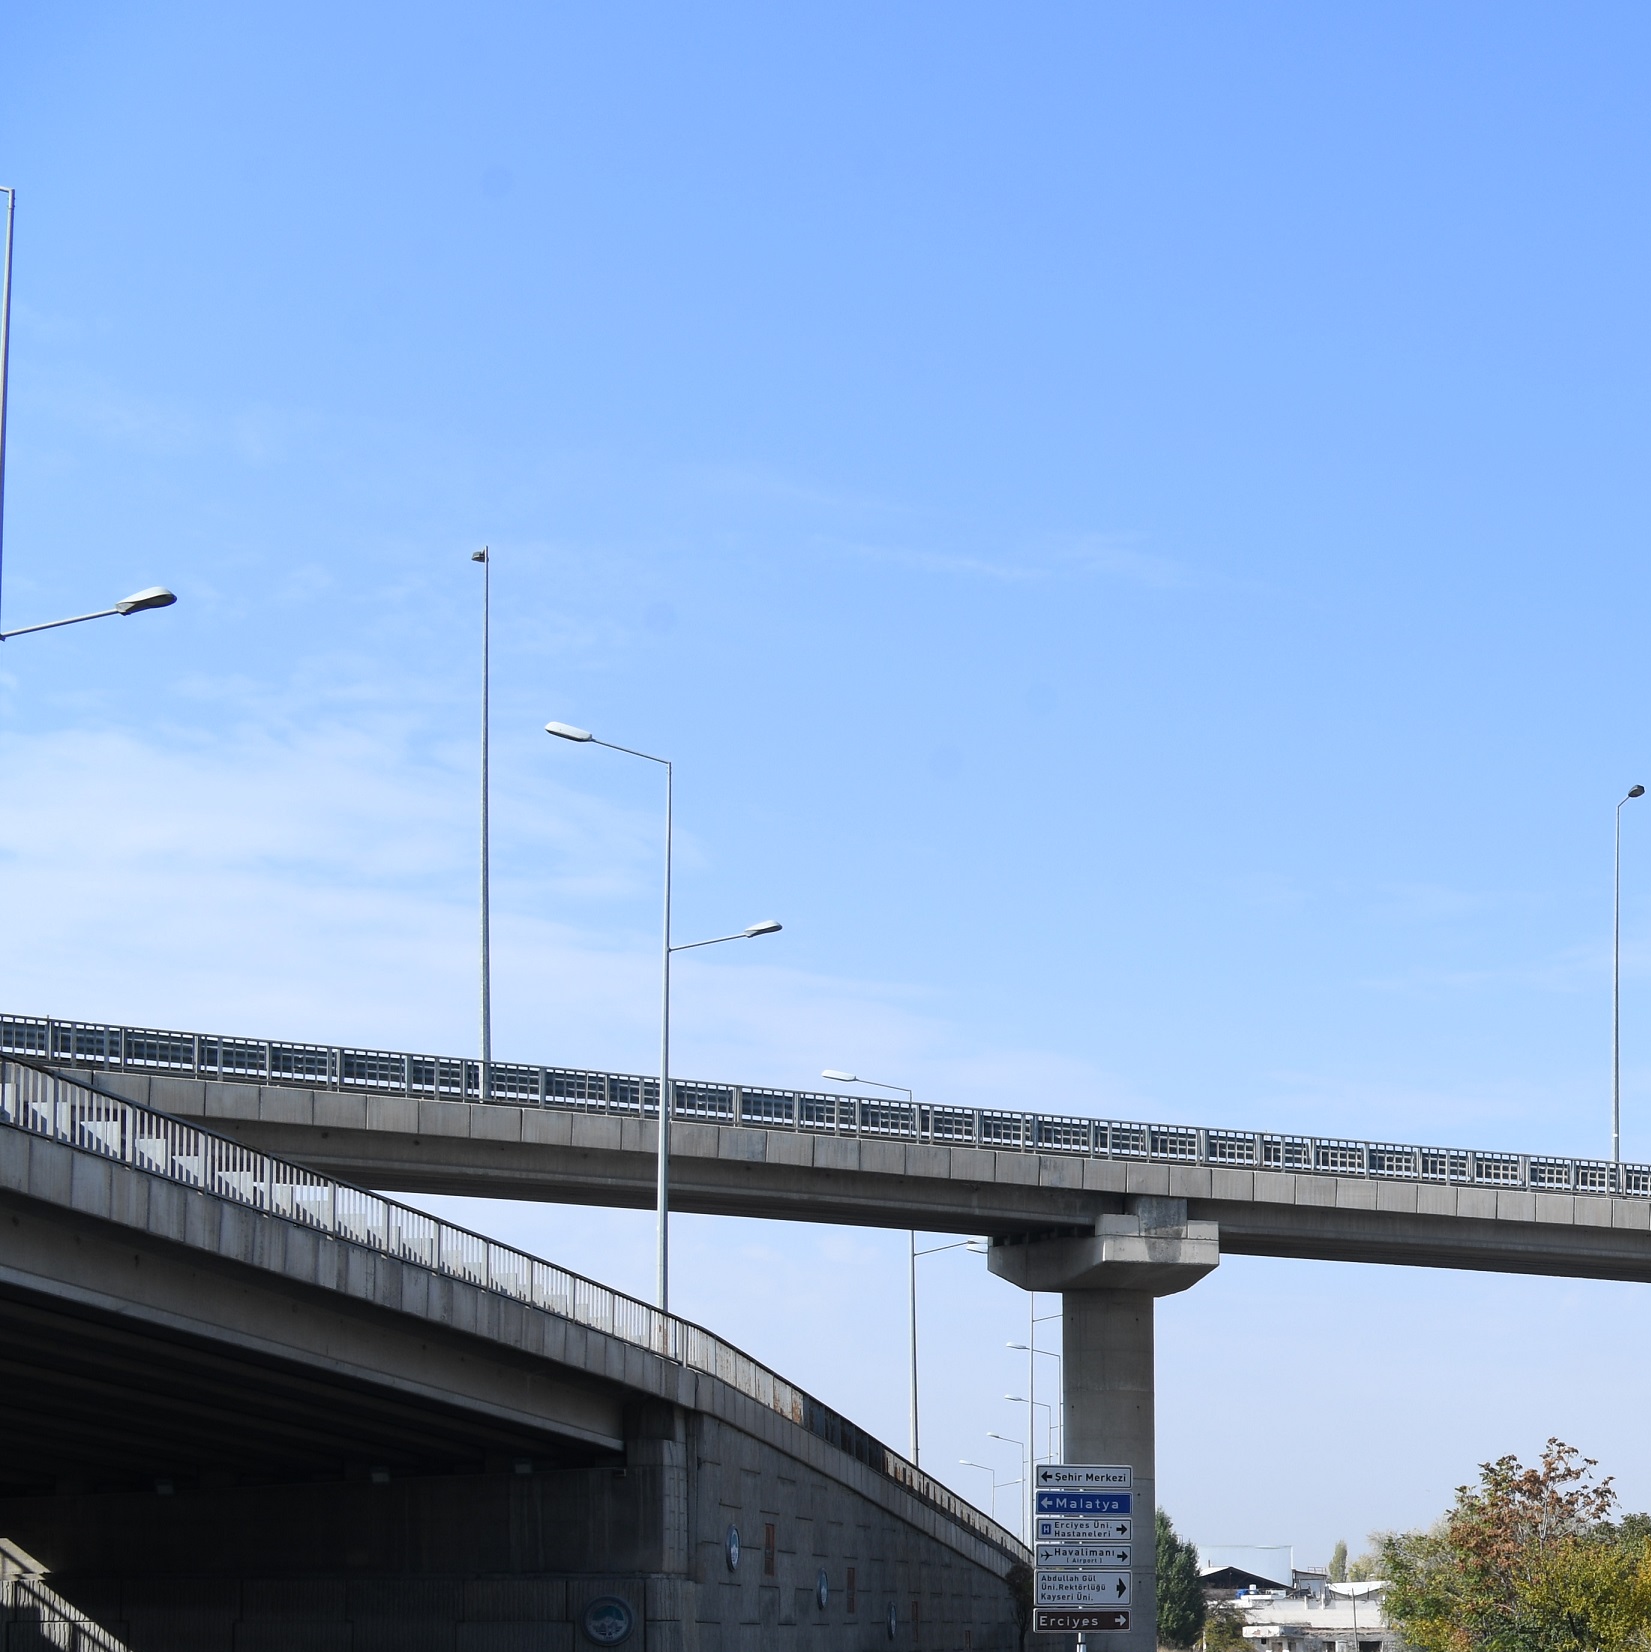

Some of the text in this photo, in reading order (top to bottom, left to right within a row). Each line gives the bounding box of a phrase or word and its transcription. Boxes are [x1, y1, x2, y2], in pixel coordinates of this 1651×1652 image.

[1055, 1473, 1126, 1482] Şehir Merkezi
[1056, 1498, 1119, 1511] Malatya
[1054, 1519, 1113, 1530] Erciyes Üni.
[1054, 1530, 1111, 1538] Hastaneleri
[1054, 1548, 1115, 1556] Havalimanı
[1041, 1591, 1094, 1601] Kayseri Üni.
[1040, 1616, 1099, 1628] Erciyes
